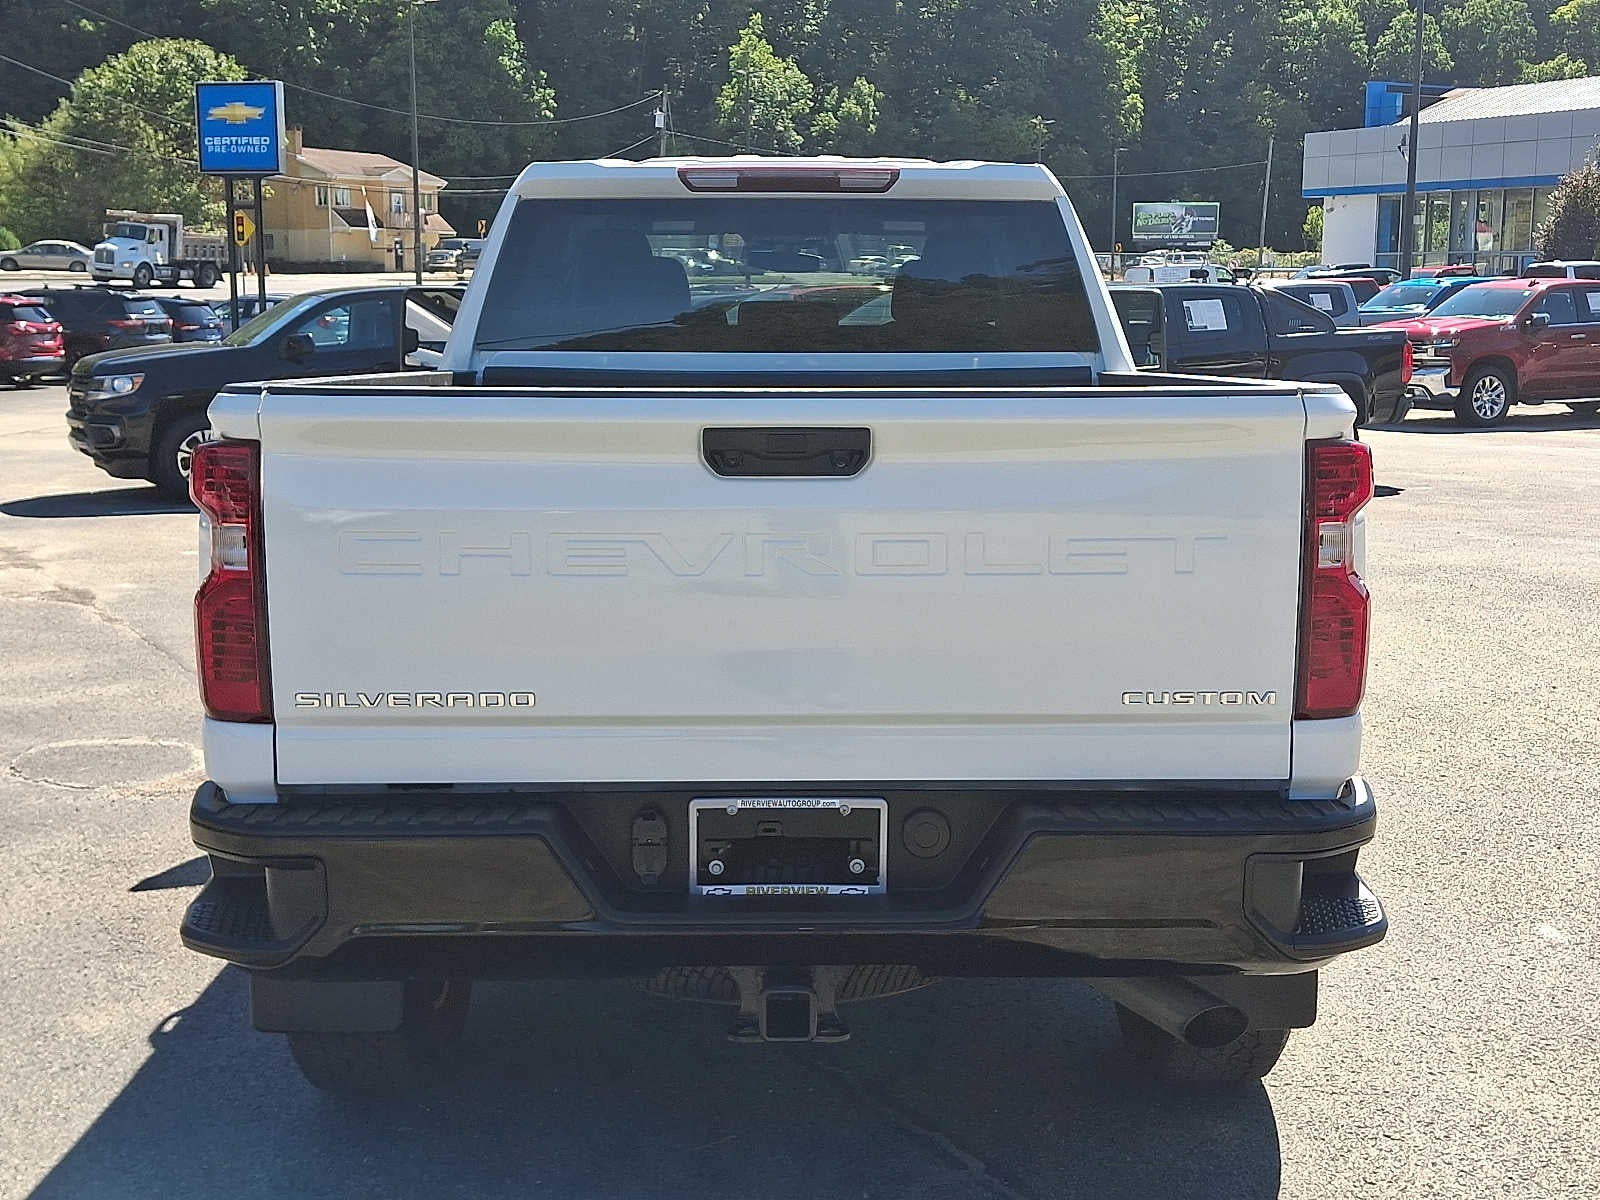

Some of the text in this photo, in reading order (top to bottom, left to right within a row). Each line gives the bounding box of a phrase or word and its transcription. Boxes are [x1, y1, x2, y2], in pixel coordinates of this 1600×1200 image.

[204, 137, 270, 145] CERTIFIED
[207, 145, 268, 153] PRE-OWNED
[338, 529, 1228, 577] CHEVROLET
[294, 692, 536, 708] SILVERADO
[1121, 691, 1277, 705] CUSTOM
[741, 800, 837, 808] RIVERVIEWAUTOGROUP.com
[746, 886, 829, 895] RIVERVIEW
